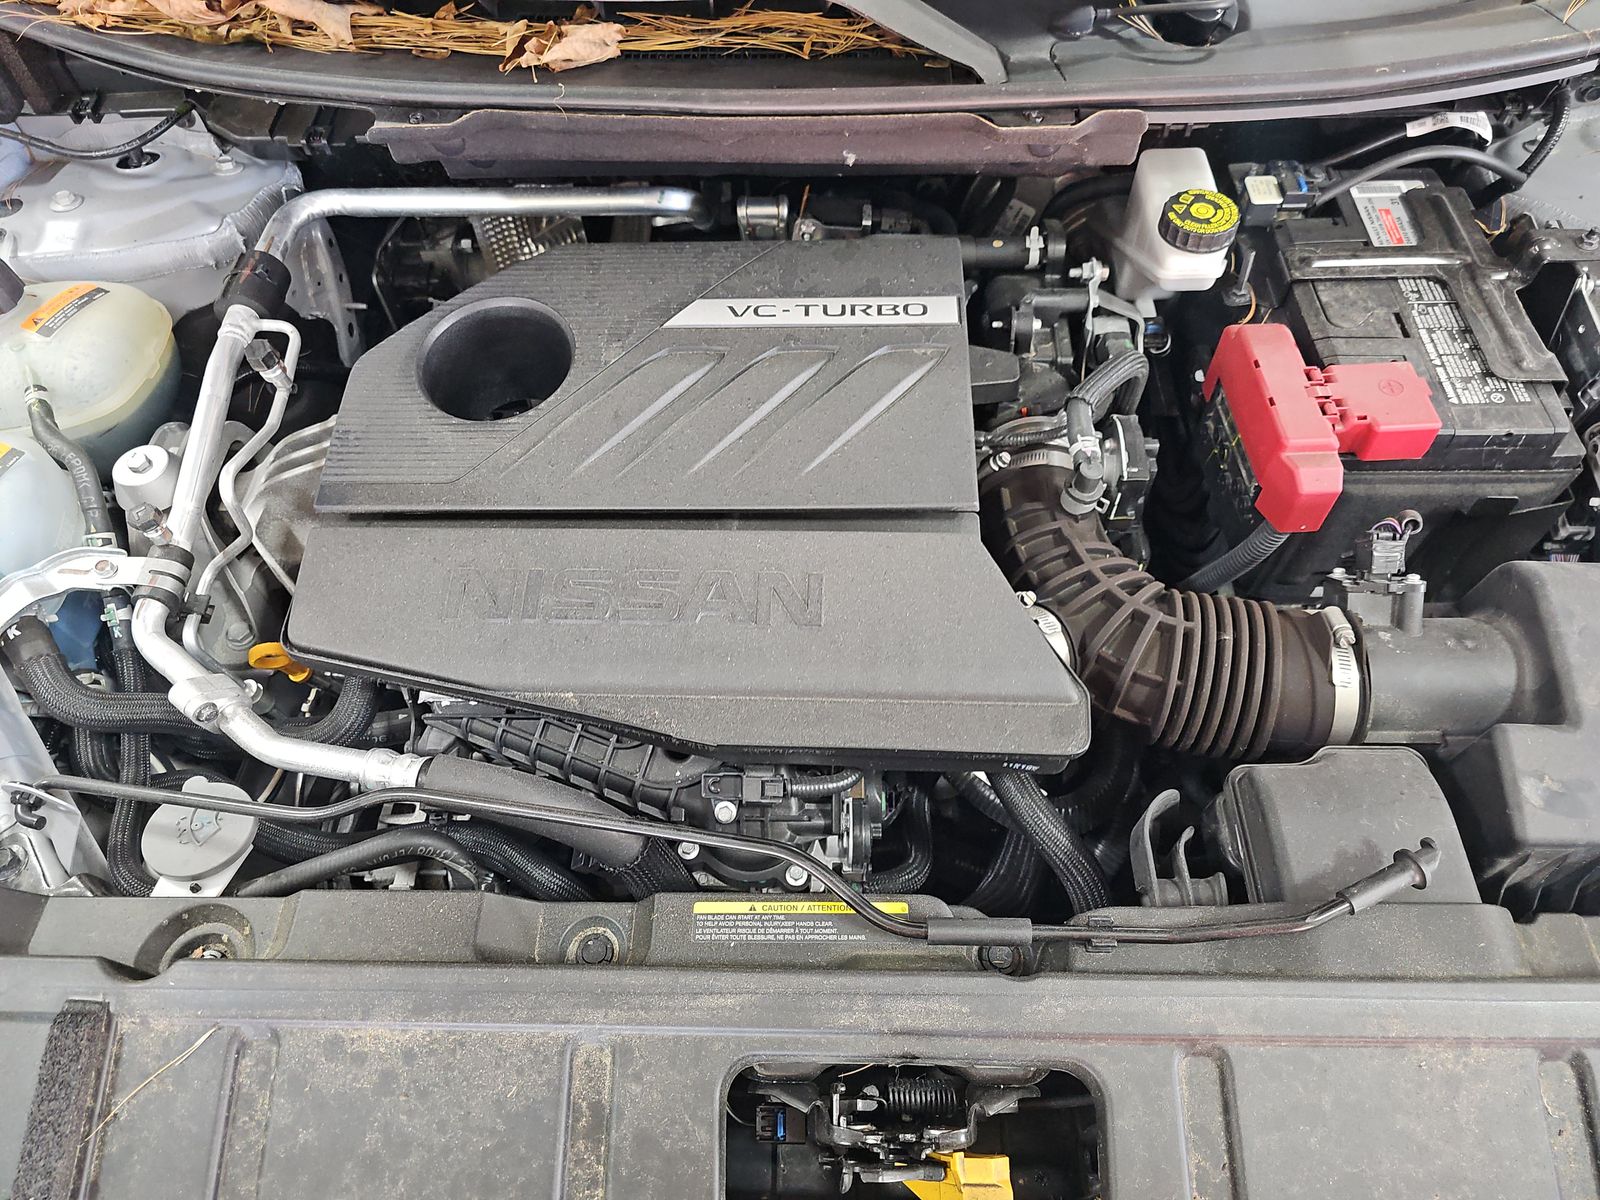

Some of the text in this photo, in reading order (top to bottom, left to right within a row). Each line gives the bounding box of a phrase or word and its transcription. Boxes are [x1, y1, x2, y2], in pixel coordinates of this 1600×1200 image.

[727, 303, 928, 317] VC-TURBO
[442, 567, 825, 627] NISSAN
[762, 904, 798, 912] CAUTION
[807, 904, 852, 912] ATTENTION
